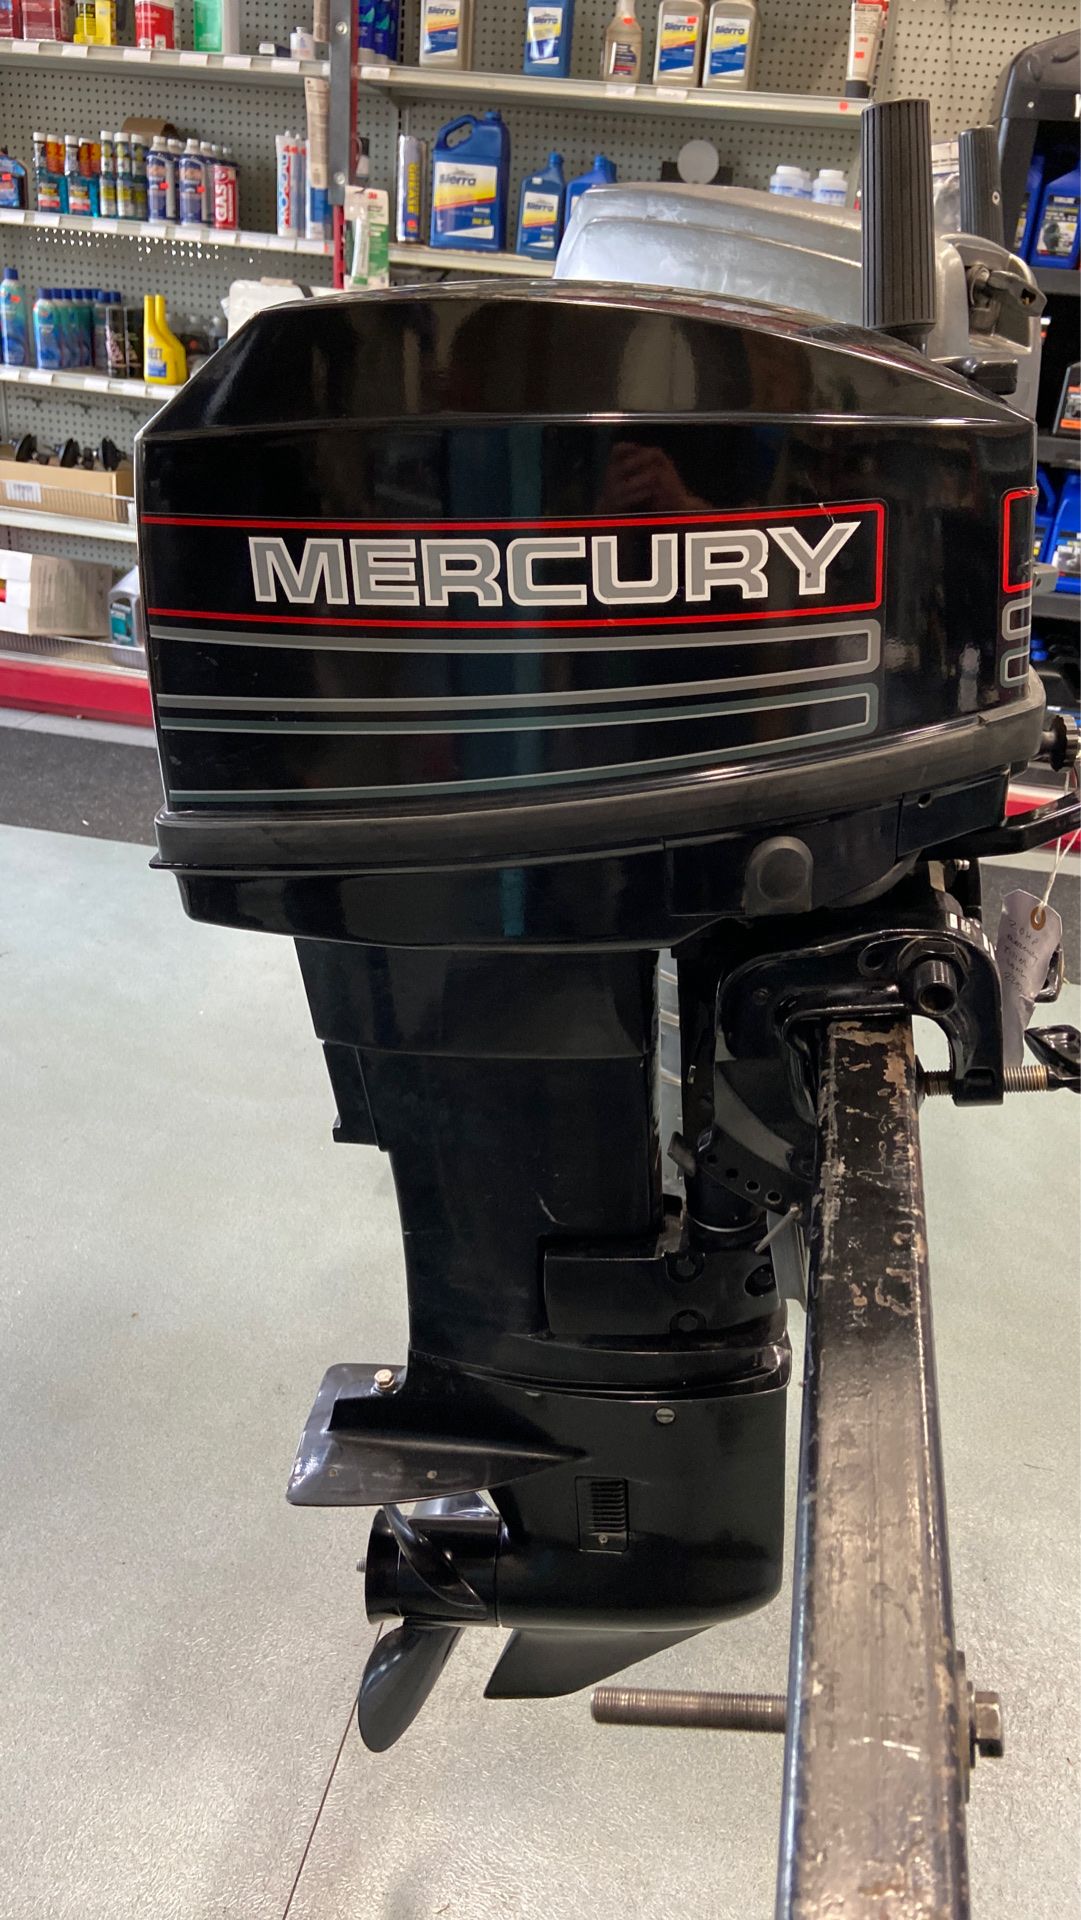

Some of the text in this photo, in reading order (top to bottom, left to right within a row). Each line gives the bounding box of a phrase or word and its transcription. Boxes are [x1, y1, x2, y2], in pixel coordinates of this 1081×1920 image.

[428, 6, 456, 16] Sierra
[664, 22, 694, 32] Sierra
[715, 25, 745, 35] Sierra
[439, 173, 476, 187] Sierra
[527, 202, 554, 213] Sierra
[248, 520, 862, 608] MERCURY
